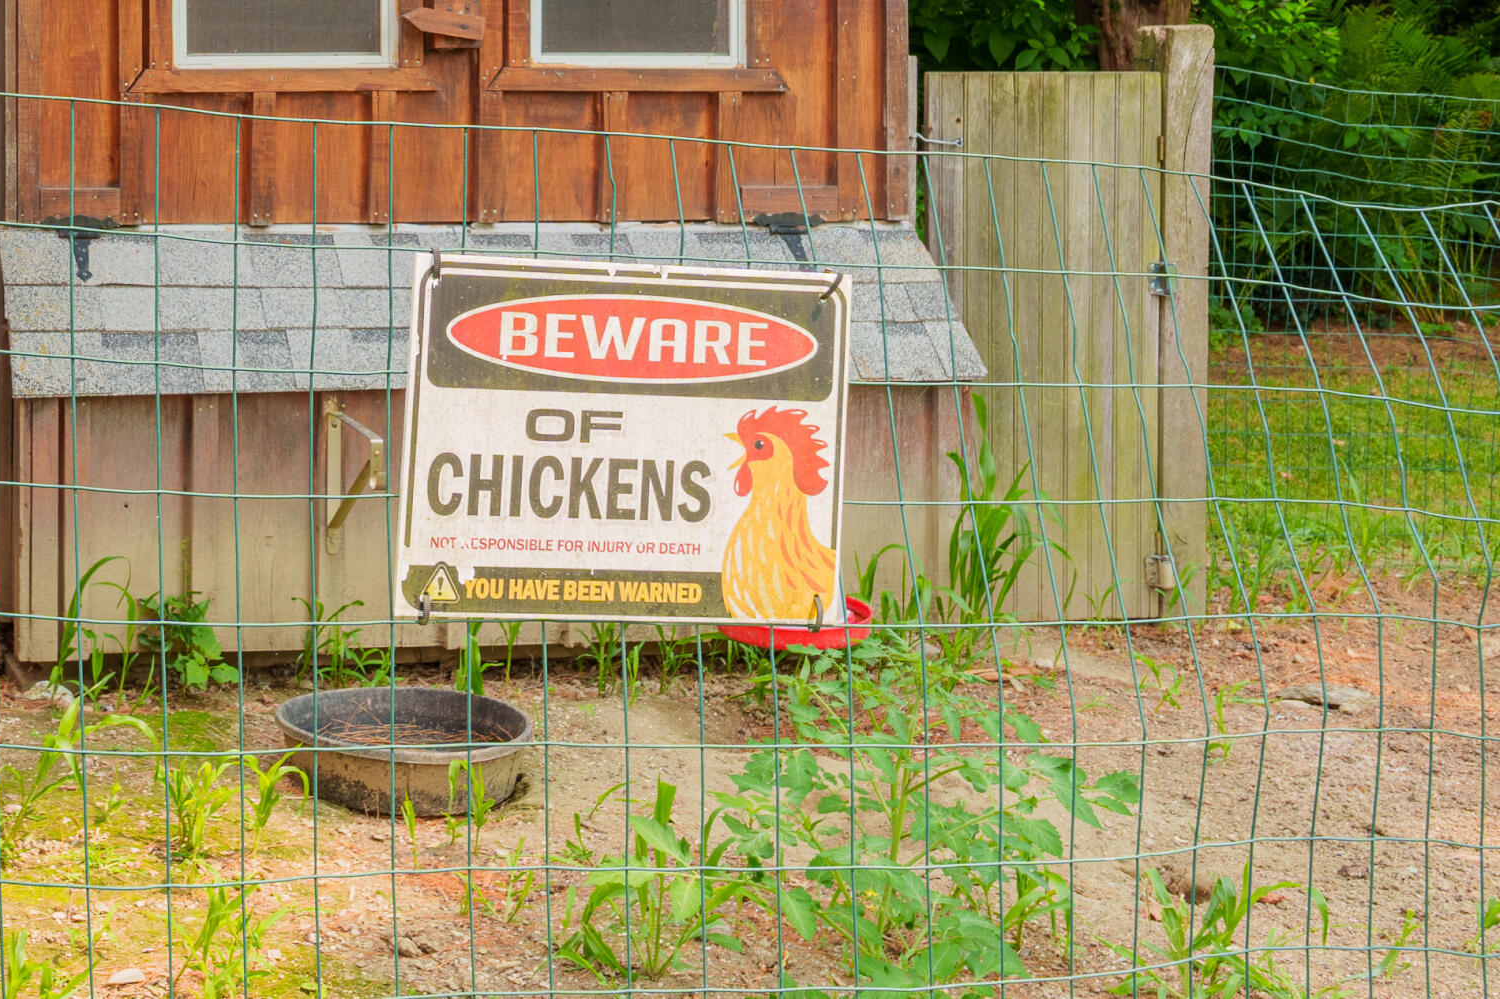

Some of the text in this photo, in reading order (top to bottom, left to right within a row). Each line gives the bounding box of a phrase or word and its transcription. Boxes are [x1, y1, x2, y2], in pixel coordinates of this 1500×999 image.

[500, 311, 769, 367] BEWARE
[525, 408, 624, 443] OF
[427, 452, 712, 523] CHICKENS
[430, 536, 701, 555] NOT ESPONSIBLE FOR INJURY OR DEATH
[465, 577, 703, 604] YOU HAVE BEEN WARNED
